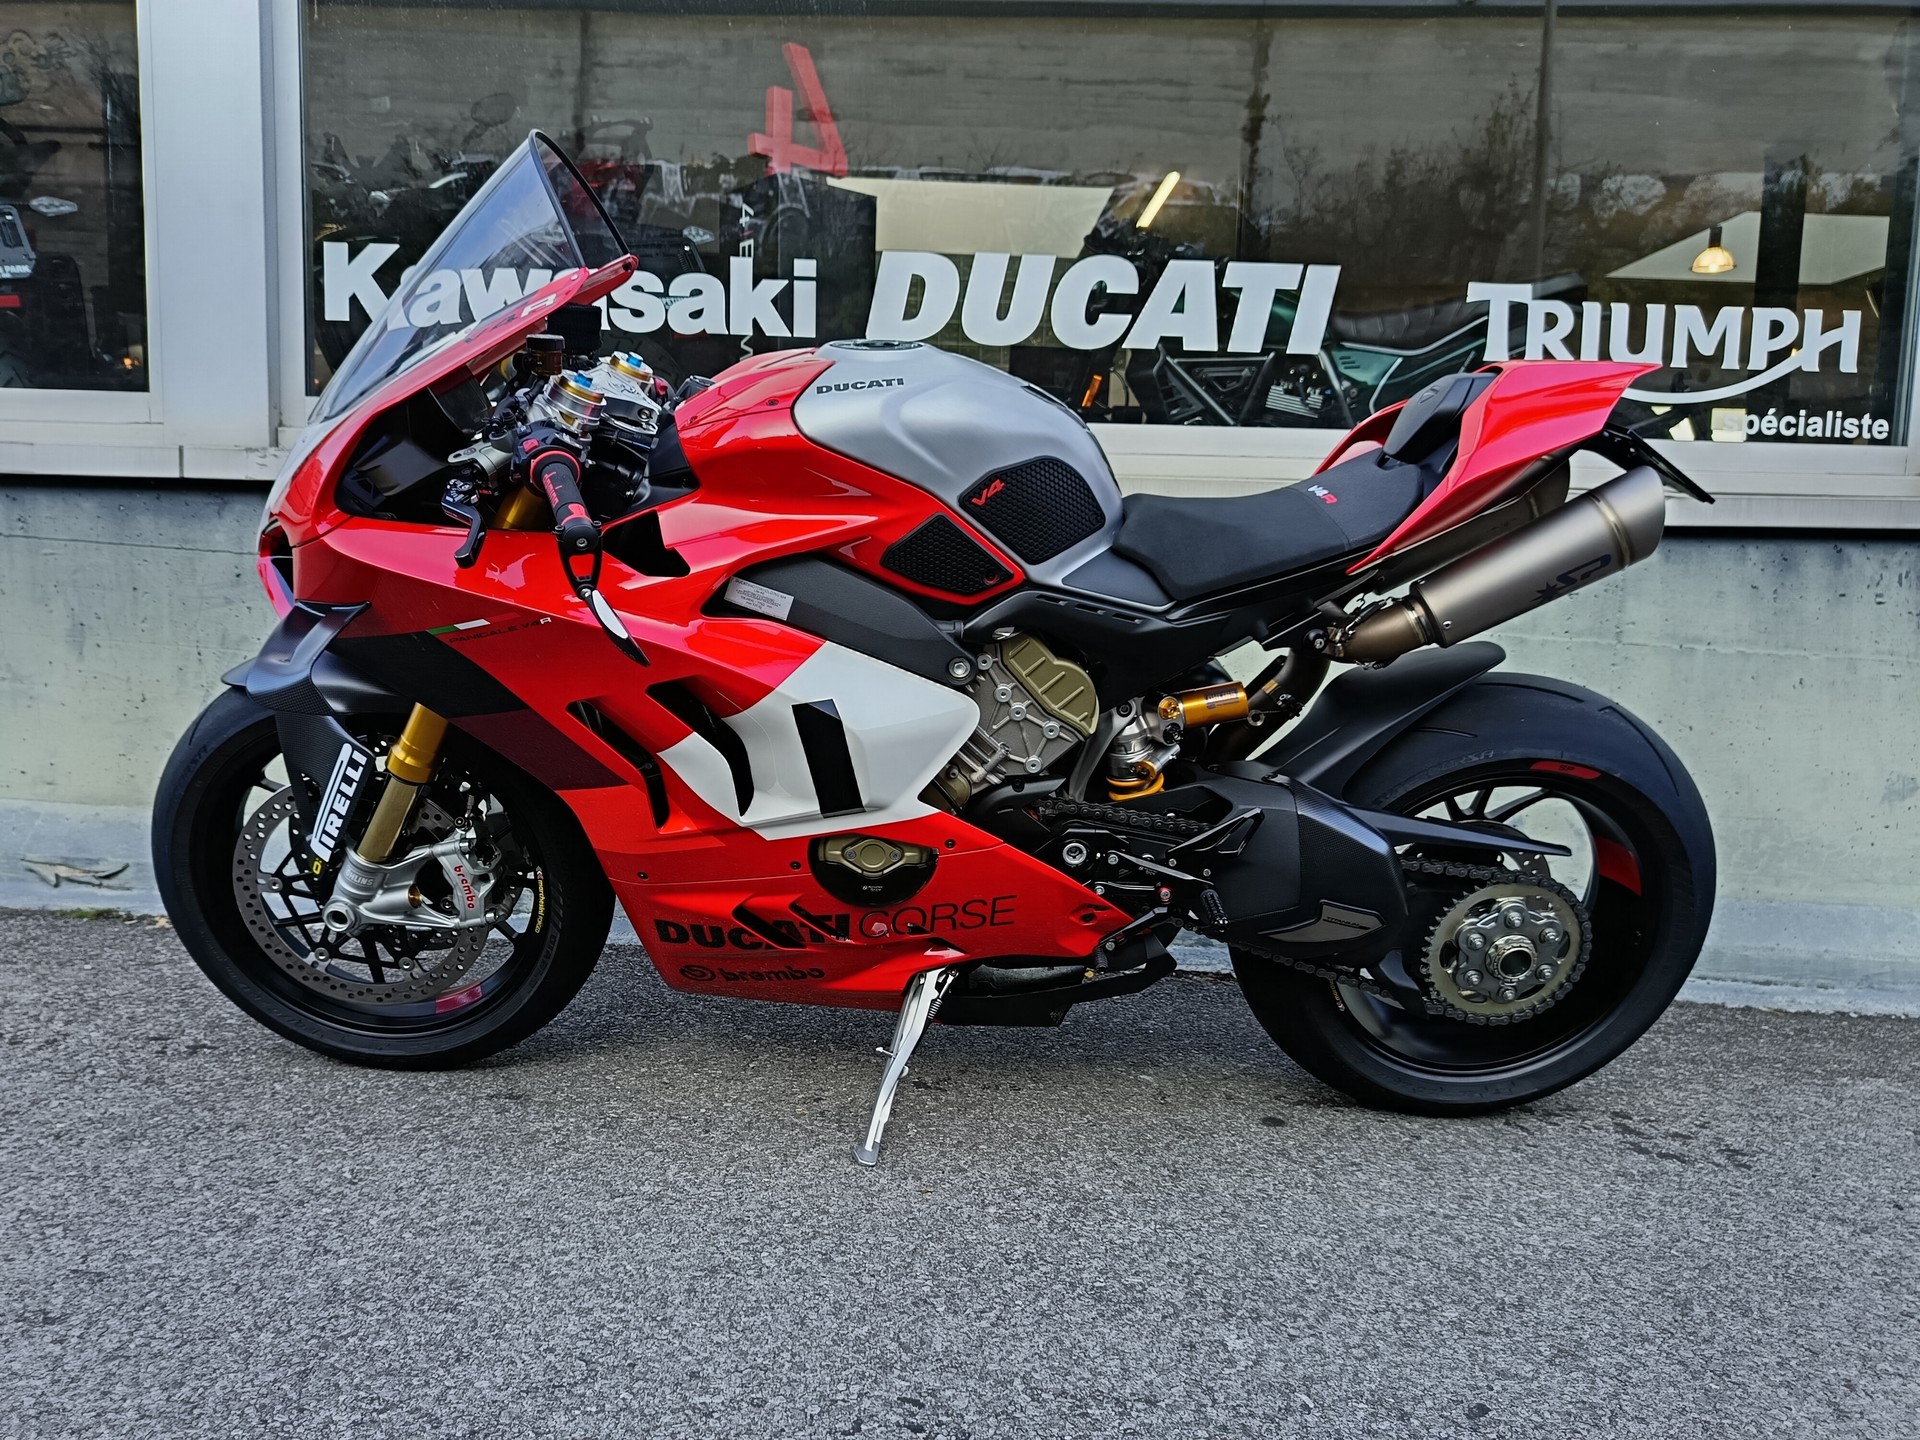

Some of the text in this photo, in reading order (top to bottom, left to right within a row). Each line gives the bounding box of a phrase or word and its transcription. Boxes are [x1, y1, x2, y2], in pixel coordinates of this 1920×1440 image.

[323, 241, 817, 339] Kawsaki
[866, 250, 1342, 355] DUCATI
[1466, 281, 1862, 374] TRIUMPH
[816, 377, 904, 395] DUCATI
[1723, 408, 1890, 441] spécialiste
[971, 480, 1005, 506] V4
[1307, 485, 1338, 504] V4R
[310, 743, 368, 862] PIRELLI
[454, 865, 475, 909] brembo
[859, 894, 1018, 938] CORSE
[717, 966, 825, 981] brembo
